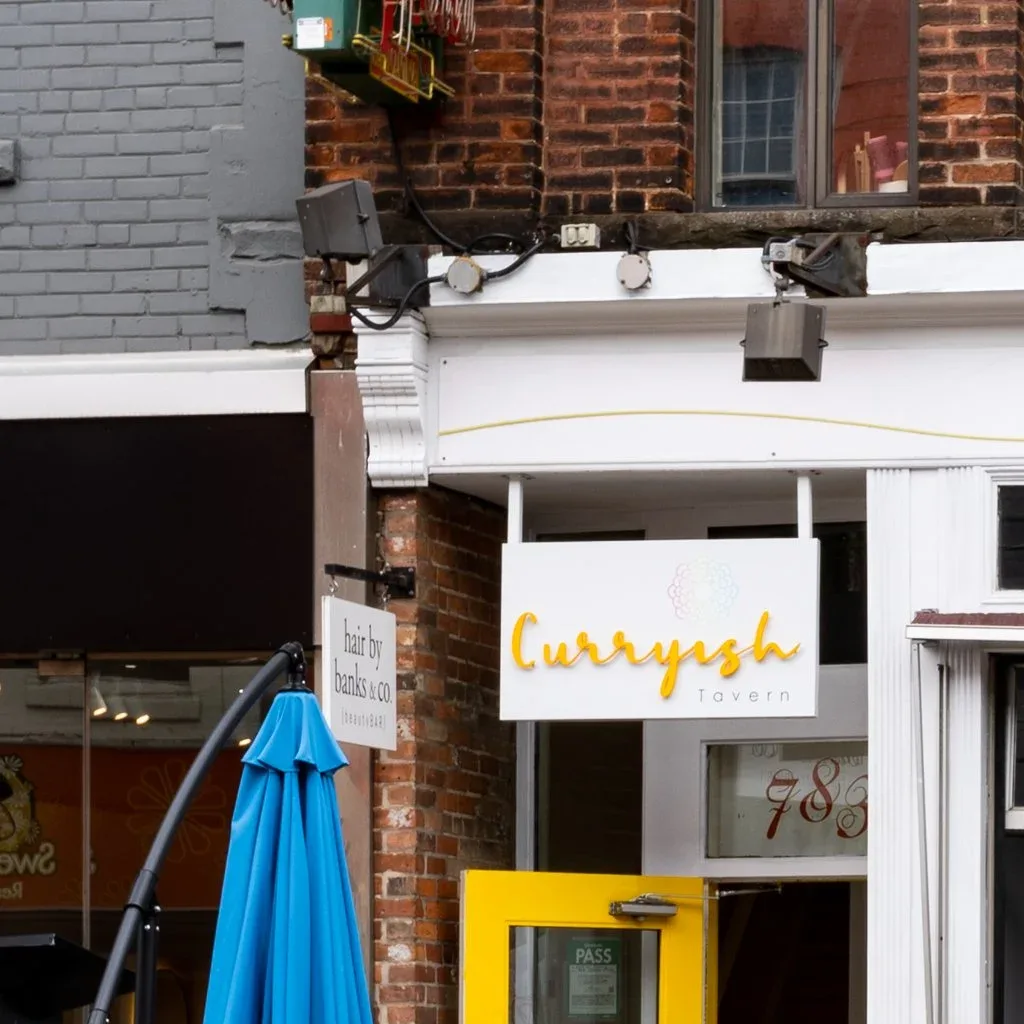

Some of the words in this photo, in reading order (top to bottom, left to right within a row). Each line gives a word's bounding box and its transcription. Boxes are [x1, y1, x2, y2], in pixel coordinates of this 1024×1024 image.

[343, 618, 366, 656] hair
[369, 624, 383, 671] by
[511, 610, 801, 699] Curryish
[334, 658, 367, 699] banks
[369, 681, 377, 701] &
[377, 681, 393, 704] co.
[698, 688, 791, 702] Tavern
[575, 948, 612, 964] PASS
